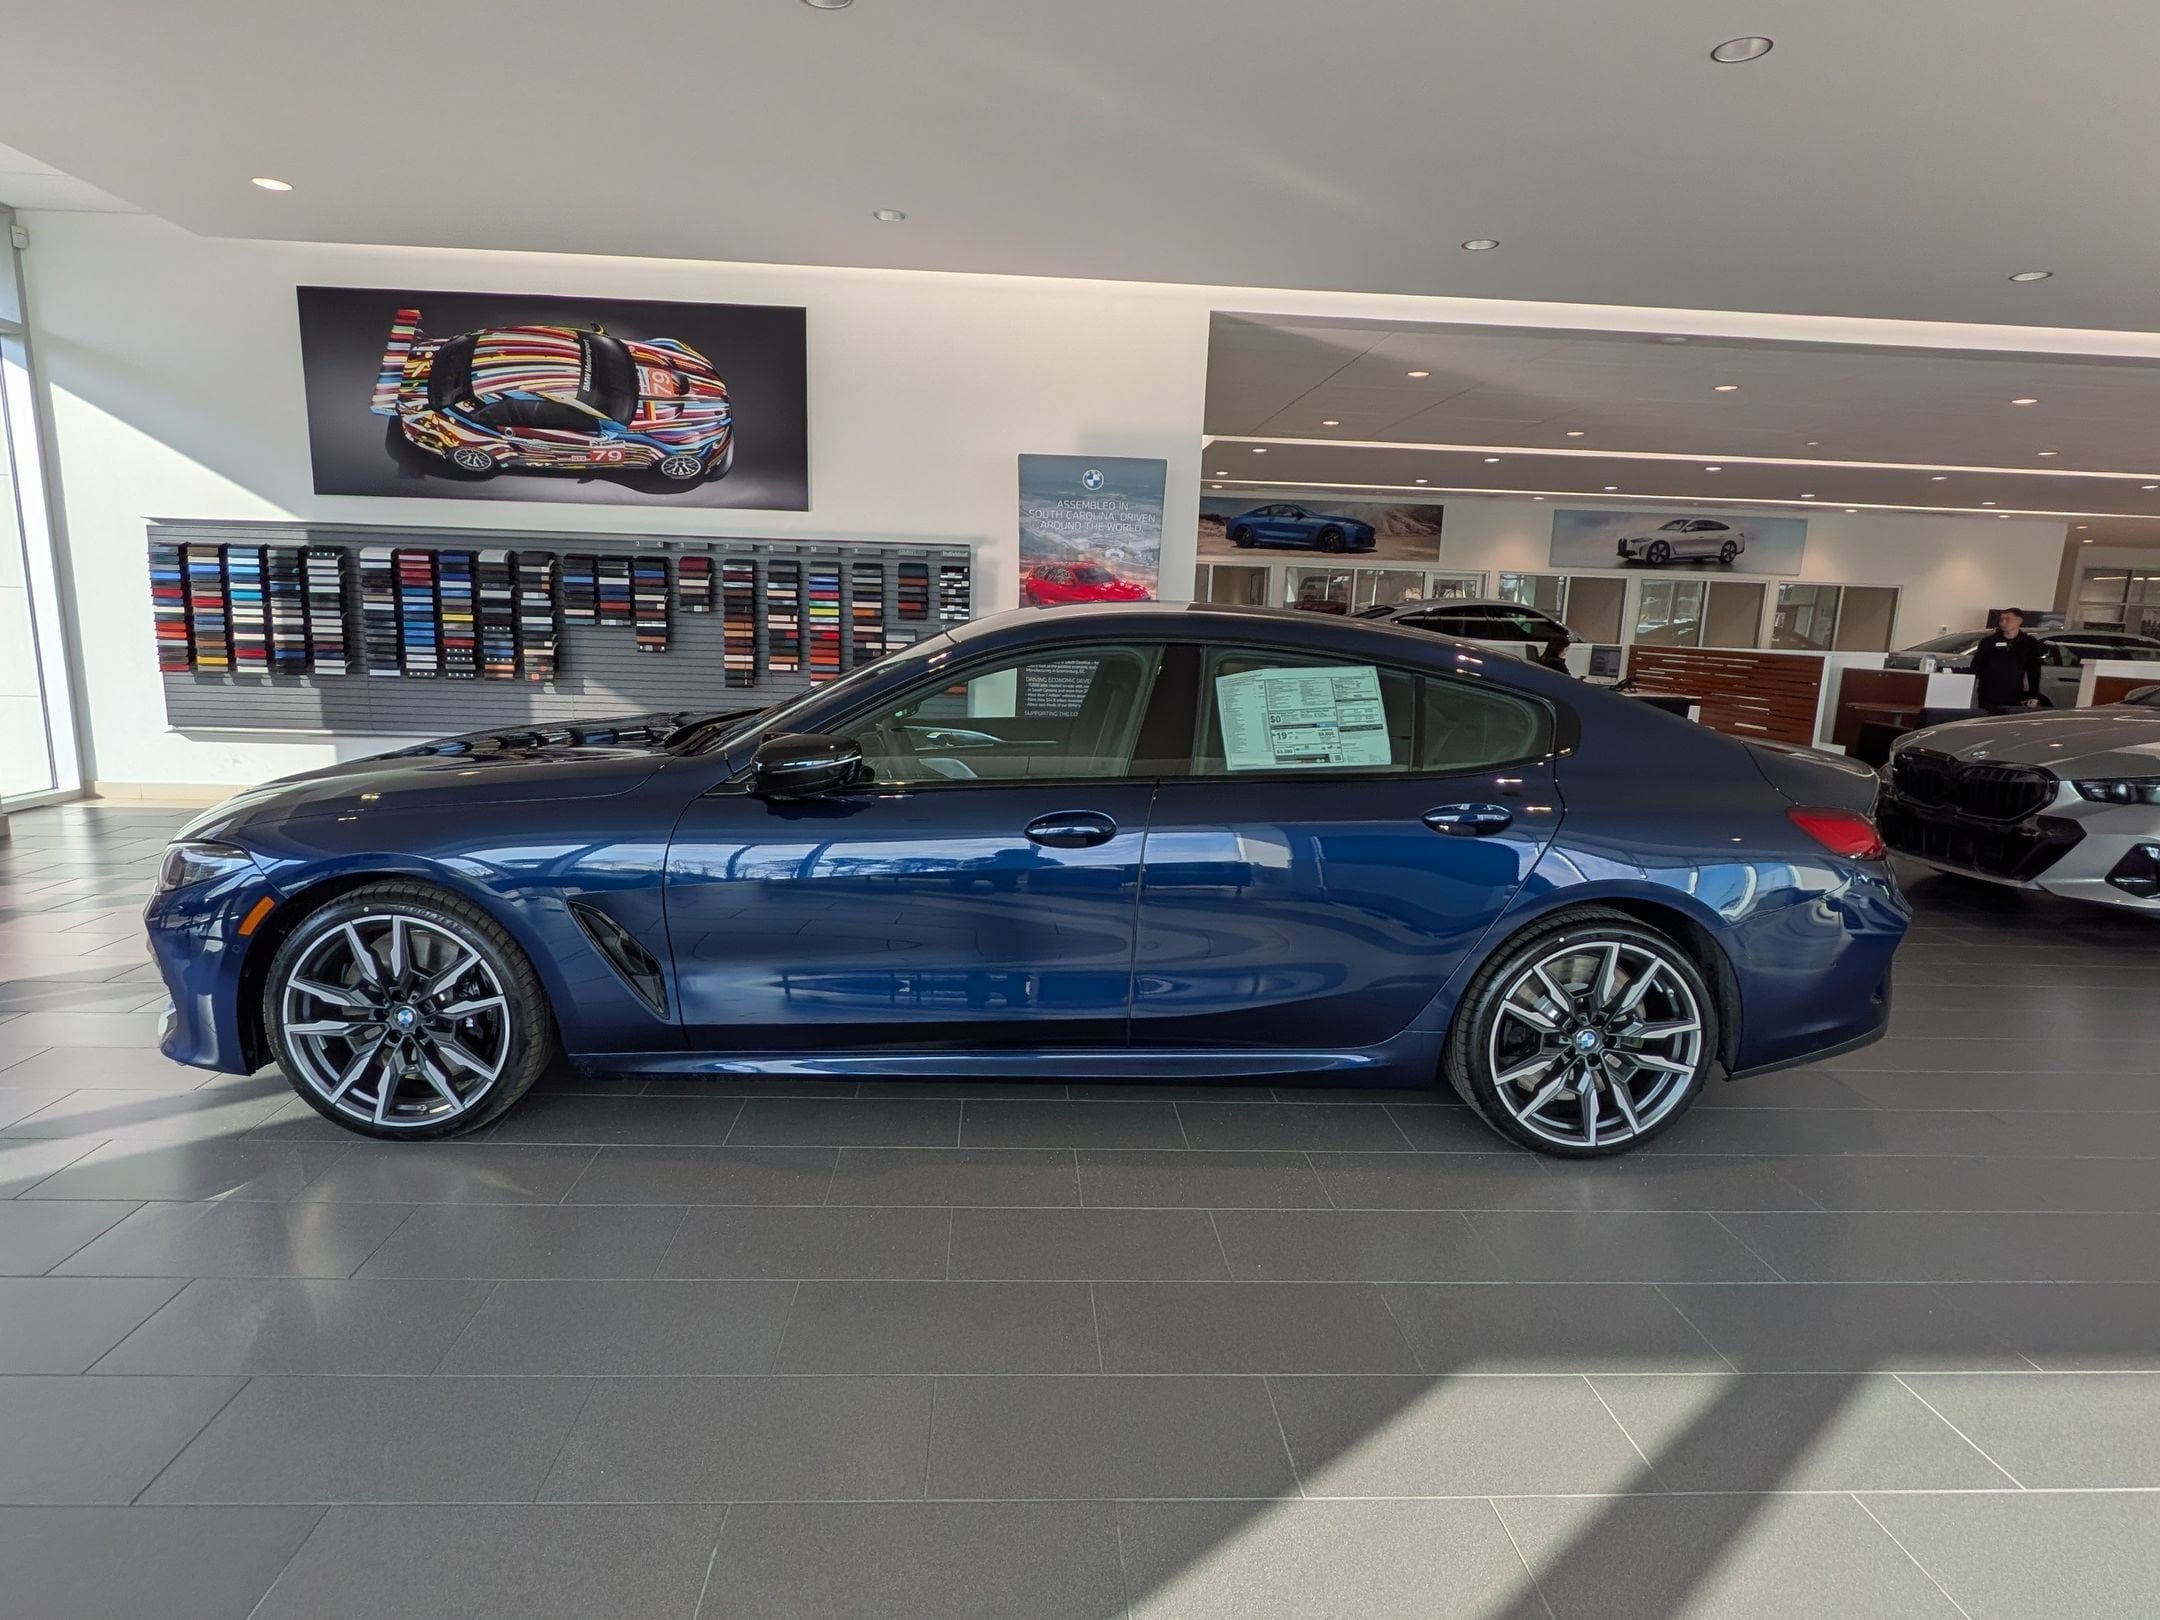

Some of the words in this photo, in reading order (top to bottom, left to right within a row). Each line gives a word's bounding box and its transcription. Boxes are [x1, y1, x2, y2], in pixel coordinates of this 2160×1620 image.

[583, 372, 592, 392] BMW
[652, 371, 672, 396] 79
[592, 450, 623, 462] 79
[1057, 500, 1116, 511] ASSEMBLED
[1119, 502, 1129, 511] IN
[1028, 509, 1063, 519] SOUTH
[1120, 512, 1156, 522] DRIVEN
[1040, 520, 1081, 530] AROUND
[1085, 521, 1104, 531] THE
[1270, 715, 1281, 723] $0
[1277, 731, 1287, 740] 19
